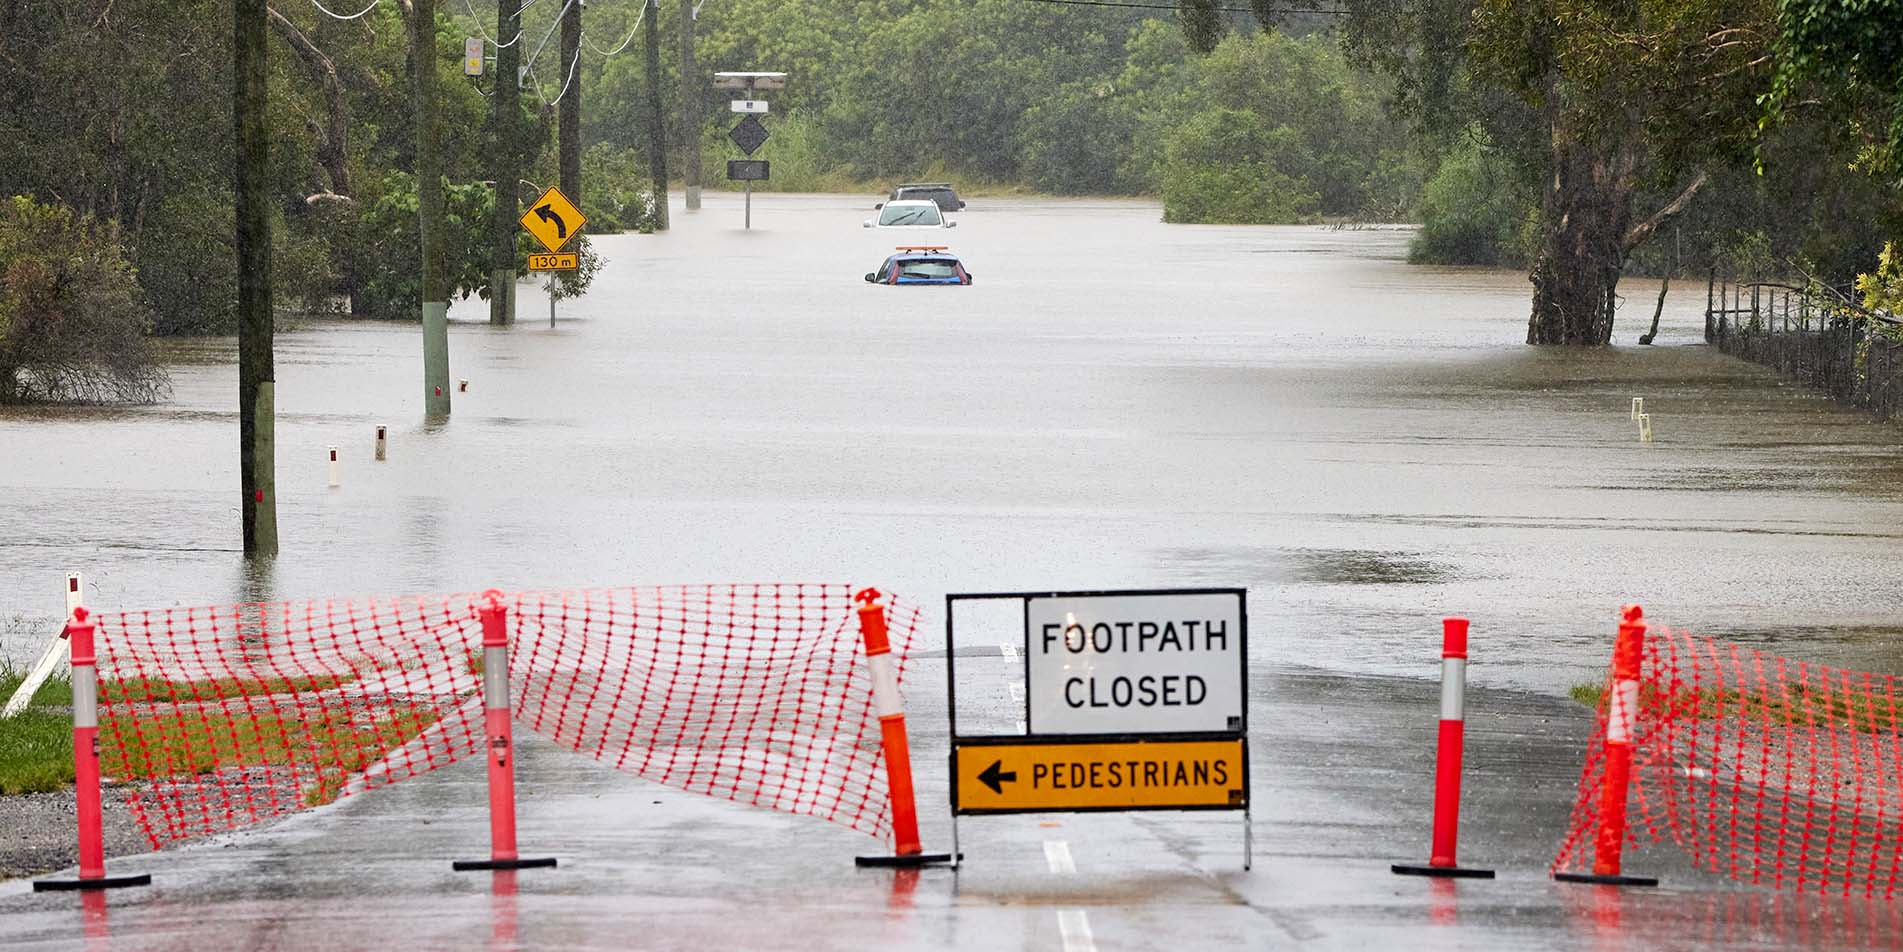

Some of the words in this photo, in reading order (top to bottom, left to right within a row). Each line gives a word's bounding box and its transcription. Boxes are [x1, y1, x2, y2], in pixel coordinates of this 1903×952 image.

[534, 256, 557, 267] 130
[1042, 620, 1227, 654] FOOTPATH
[1064, 675, 1207, 708] CLOSED
[1033, 759, 1228, 789] PEDESTRIANS
